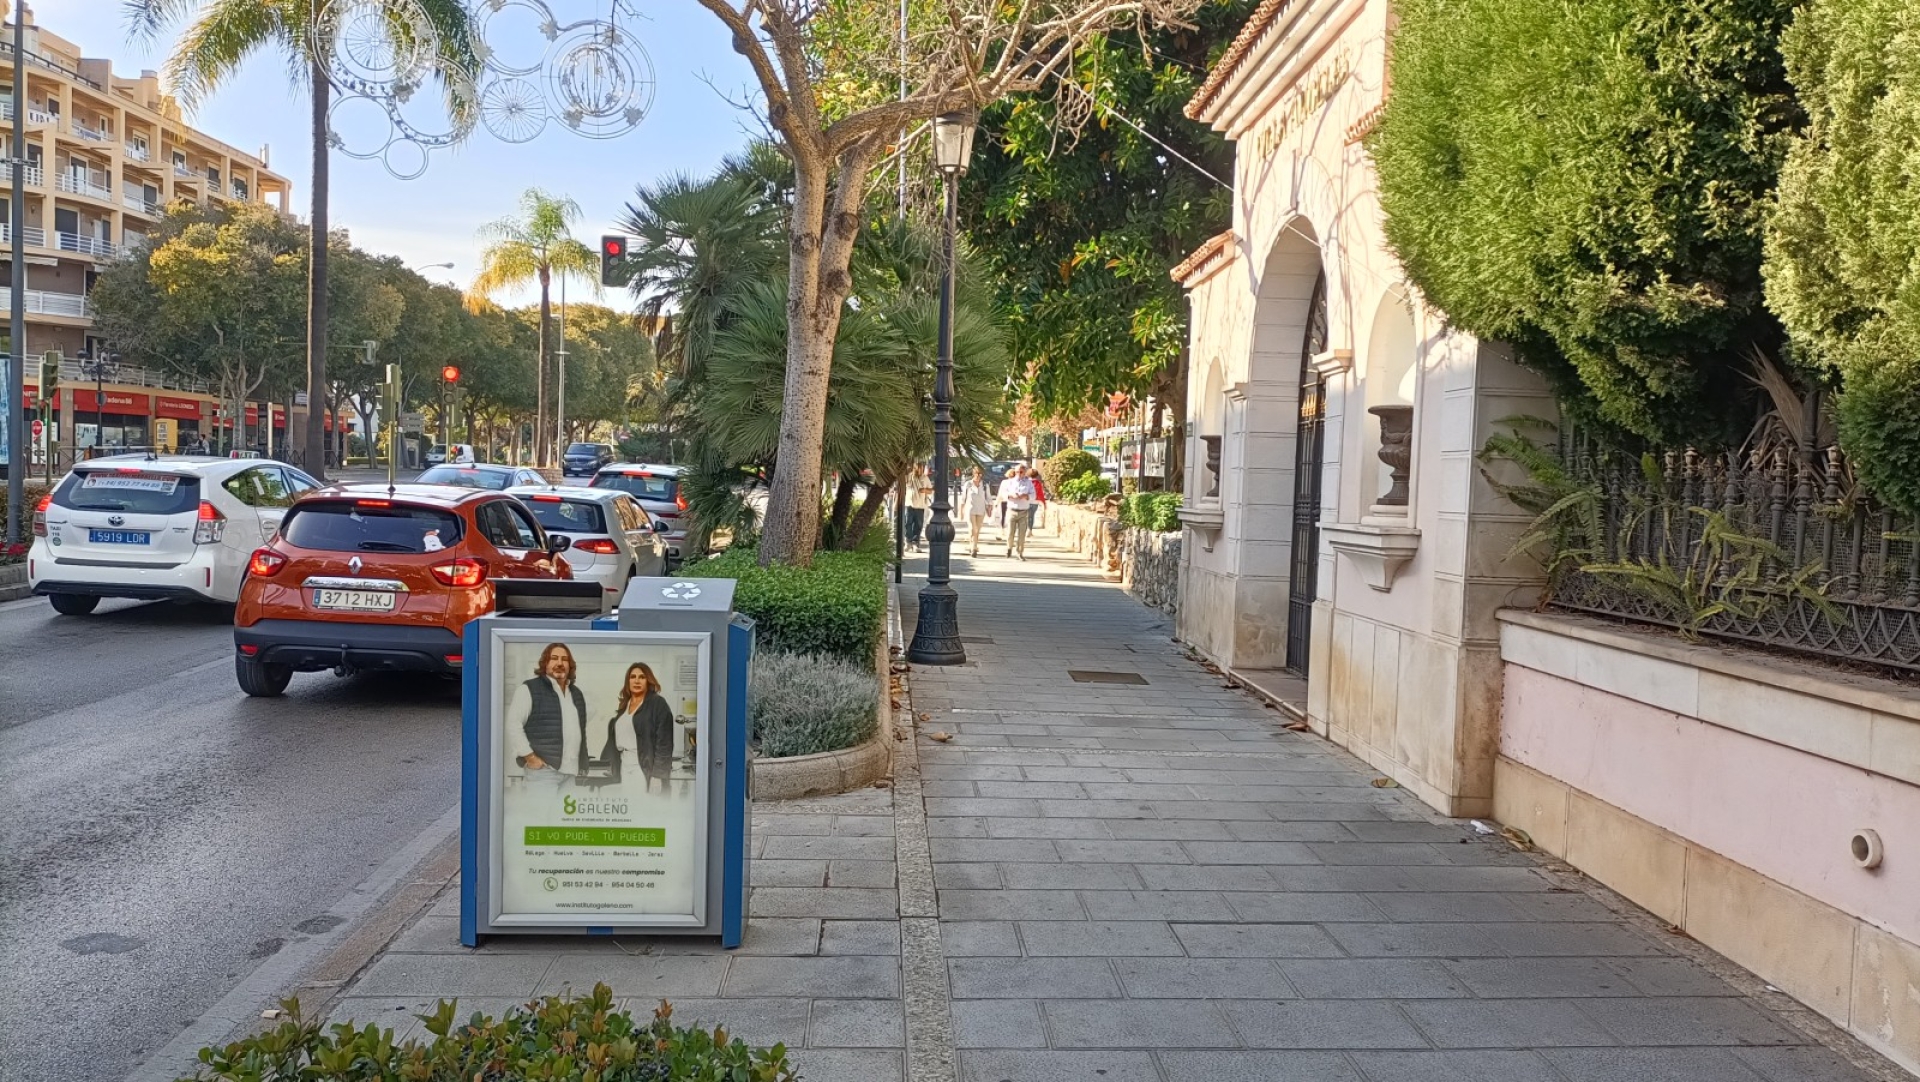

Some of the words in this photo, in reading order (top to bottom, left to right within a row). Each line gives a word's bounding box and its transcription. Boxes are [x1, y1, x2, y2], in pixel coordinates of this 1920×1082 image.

[98, 531, 122, 542] 5919
[126, 533, 145, 543] LDR
[323, 592, 360, 606] 3712
[365, 594, 392, 607] HXJ
[577, 803, 629, 815] GALENO
[528, 831, 540, 841] SI
[602, 830, 615, 841] TÚ
[620, 832, 656, 842] PUEDES
